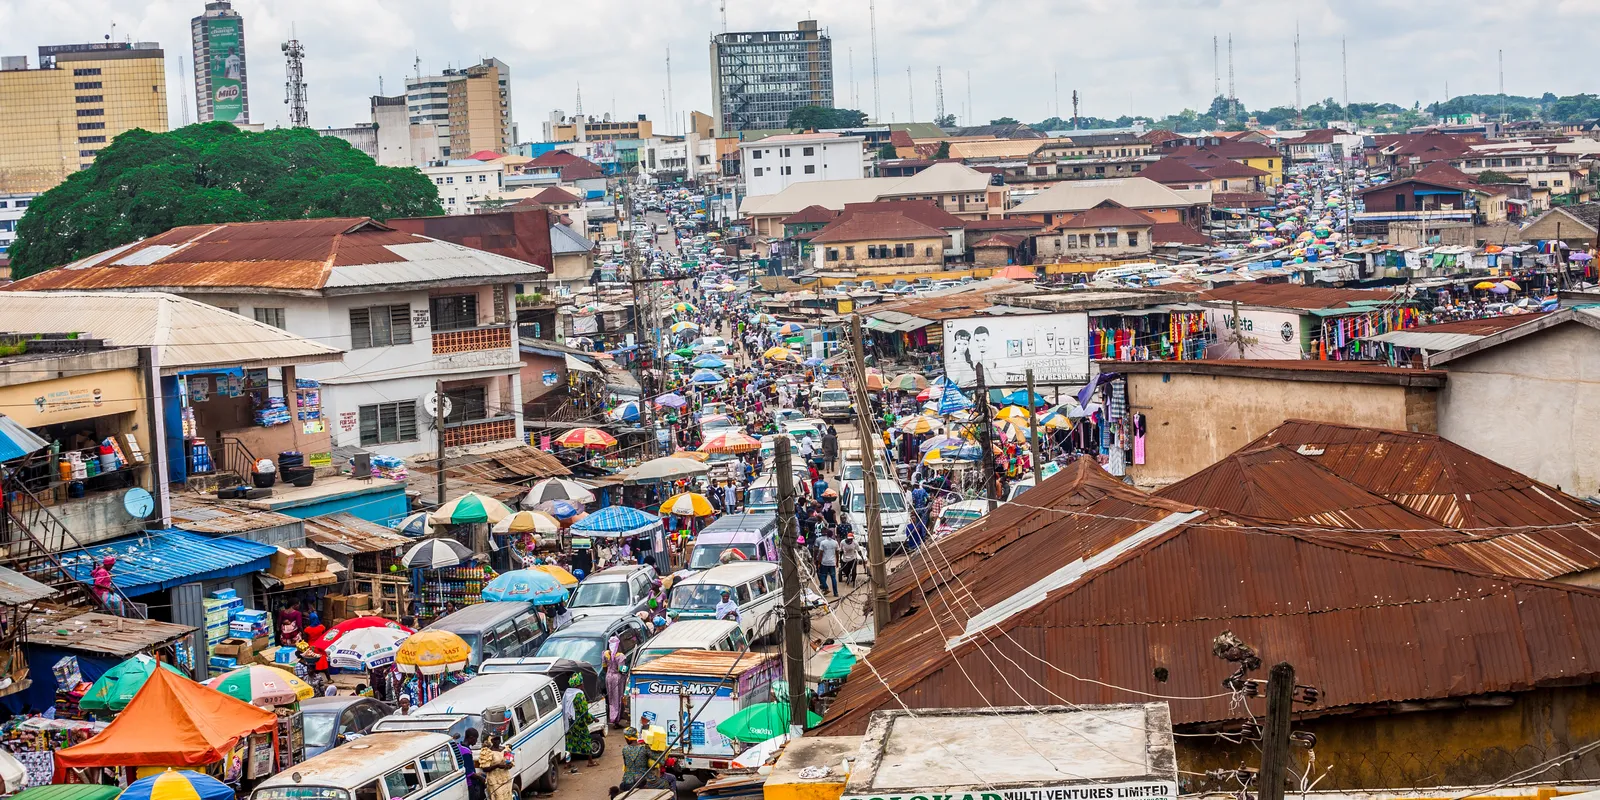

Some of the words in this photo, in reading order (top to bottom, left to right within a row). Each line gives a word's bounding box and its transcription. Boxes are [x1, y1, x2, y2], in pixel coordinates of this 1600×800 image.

[218, 89, 238, 98] MILO
[1223, 314, 1253, 331] Veeta
[1024, 359, 1066, 367] PASSION
[1004, 791, 1042, 800] MULTI
[1046, 788, 1113, 800] VENTURES
[1117, 785, 1169, 797] LIMITED
